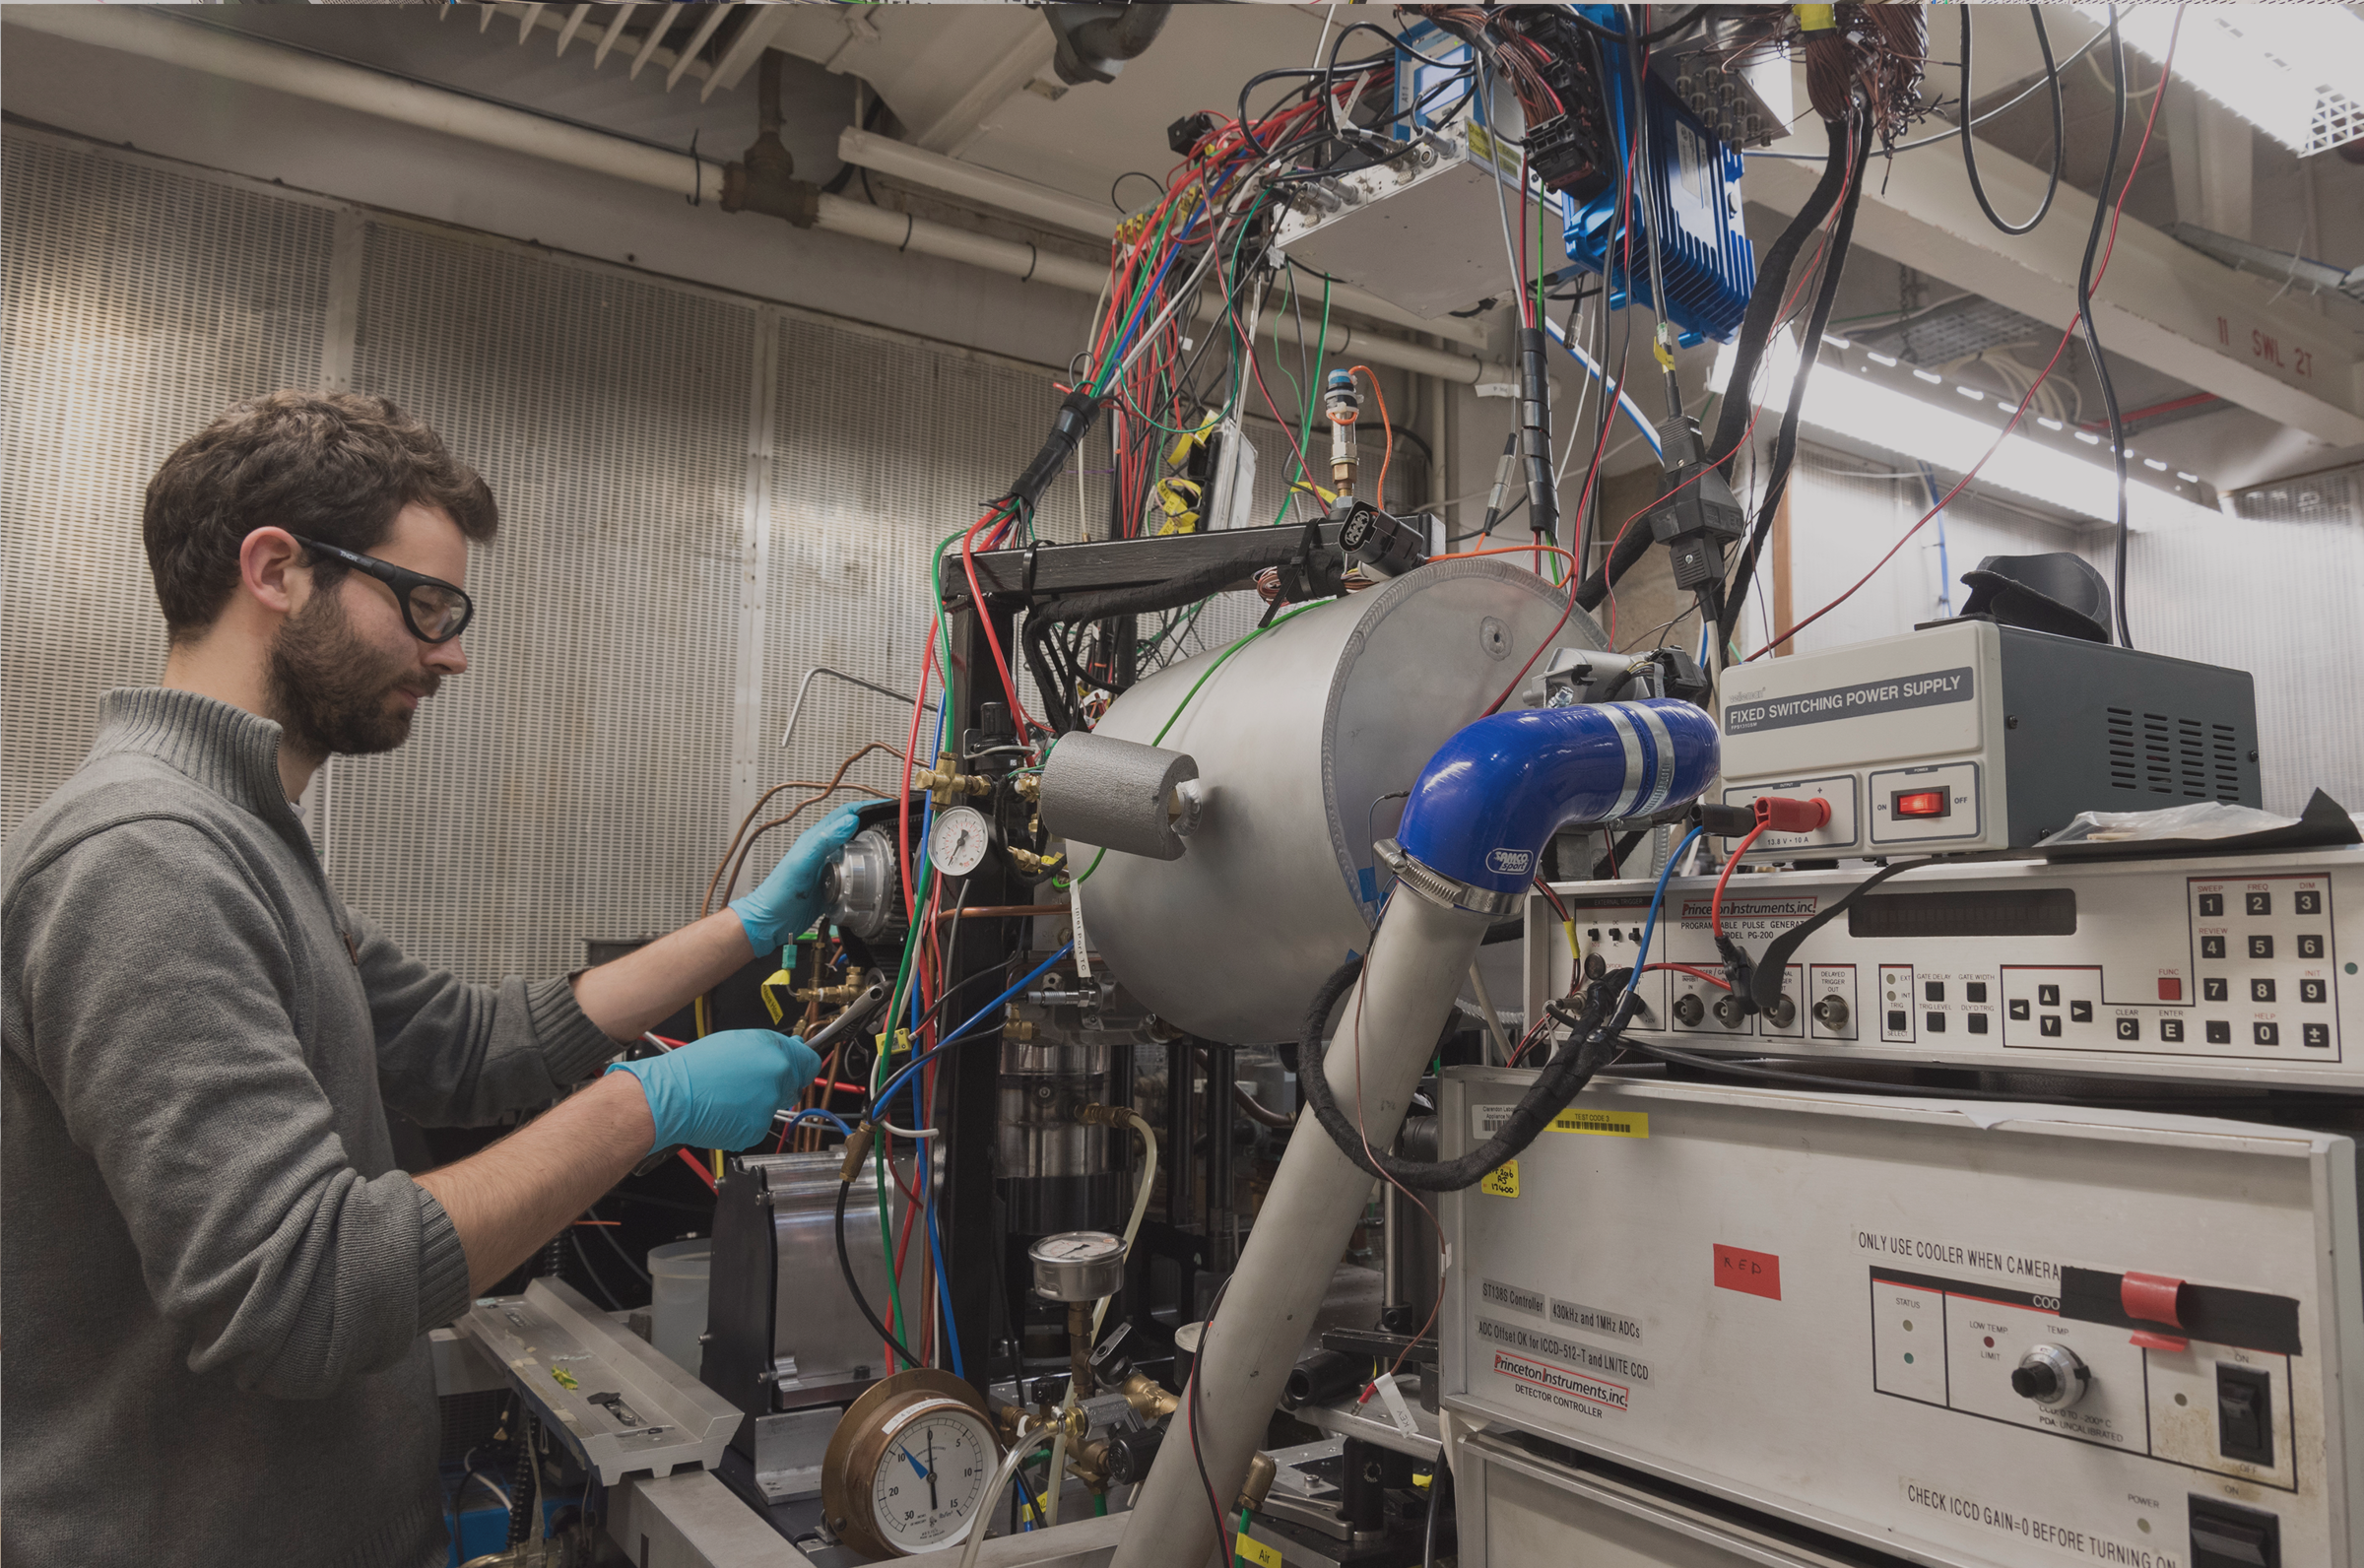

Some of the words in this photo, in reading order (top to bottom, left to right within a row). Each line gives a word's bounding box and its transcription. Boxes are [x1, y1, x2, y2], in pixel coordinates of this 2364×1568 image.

[2252, 329, 2285, 369] SWL
[2295, 347, 2313, 378] 2T
[1731, 707, 1765, 724] FIXED
[1768, 695, 1843, 719] SWITCHING
[1846, 686, 1898, 705] POWER
[1903, 675, 1961, 697] SUPPLY
[1954, 796, 1968, 805] OFF
[1767, 837, 1781, 846] 13.8
[1493, 851, 1529, 864] SAMCO
[1502, 862, 1525, 872] sport
[1681, 902, 1731, 916] Princeon
[2206, 898, 2214, 912] 1
[2253, 897, 2264, 910] 2
[2301, 896, 2312, 910] 3
[1680, 921, 1738, 930] PROGRAMABLE
[1741, 921, 1765, 930] PULSE
[1747, 931, 1774, 940] PG-200
[2206, 941, 2216, 954] 4
[2255, 941, 2266, 953] 5
[2304, 940, 2315, 953] 6
[1081, 957, 1086, 971] TC
[2209, 983, 2219, 997] 7
[2257, 984, 2267, 998] 8
[2306, 984, 2318, 998] 9
[2120, 1022, 2132, 1036] C
[2165, 1023, 2177, 1037] E
[2260, 1026, 2270, 1040] 0
[1859, 1232, 1886, 1252] ONLY
[1890, 1237, 1913, 1257] USE
[1916, 1241, 1964, 1265] COOLER
[1967, 1249, 2003, 1272] WHEN
[2006, 1256, 2061, 1280] CAMERA
[1724, 1257, 1762, 1275] RED
[1482, 1282, 1508, 1303] ST138S
[1509, 1290, 1543, 1313] Controller
[1896, 1297, 1921, 1310] STATUS
[2033, 1295, 2061, 1311] COO
[1552, 1303, 1579, 1324] 430kHz
[1580, 1312, 1594, 1327] and
[1596, 1314, 1616, 1333] 1MHz
[1618, 1319, 1640, 1339] ADCs
[1969, 1321, 1985, 1331] LOW
[1478, 1321, 1493, 1338] ADC
[1493, 1325, 1516, 1343] Offset
[1517, 1331, 1528, 1347] OK
[1529, 1335, 1540, 1349] for
[1540, 1338, 1587, 1363] ICCD-512-T
[1588, 1352, 1603, 1368] and
[1604, 1354, 1628, 1375] LN/TE
[1630, 1362, 1649, 1381] CCD
[1981, 1350, 2001, 1361] LIMIT
[2235, 1353, 2250, 1363] ON
[1494, 1354, 1543, 1381] Princeton
[1515, 1383, 1552, 1403] DETECTOR
[1552, 1395, 1603, 1418] CONTROLLER
[1397, 1409, 1411, 1428] KEY
[2067, 1409, 2077, 1420] TO
[2105, 1418, 2112, 1429] C
[2060, 1420, 2124, 1443] UNCALIBRATED
[955, 1438, 961, 1448] 5
[897, 1453, 906, 1463] 10
[964, 1468, 972, 1477] 10
[2239, 1464, 2258, 1474] OFF
[888, 1486, 899, 1497] 20
[2224, 1484, 2240, 1496] ON
[950, 1498, 958, 1509] 15
[2128, 1492, 2160, 1509] POWER
[904, 1510, 915, 1521] 30
[1907, 1484, 1947, 1512] CHECK
[1949, 1490, 1981, 1522] ICCD
[1983, 1507, 2029, 1536] GAIN=0
[2032, 1521, 2085, 1553] BEFORE
[2089, 1536, 2151, 1568] TURNING
[1258, 1549, 1271, 1565] Air
